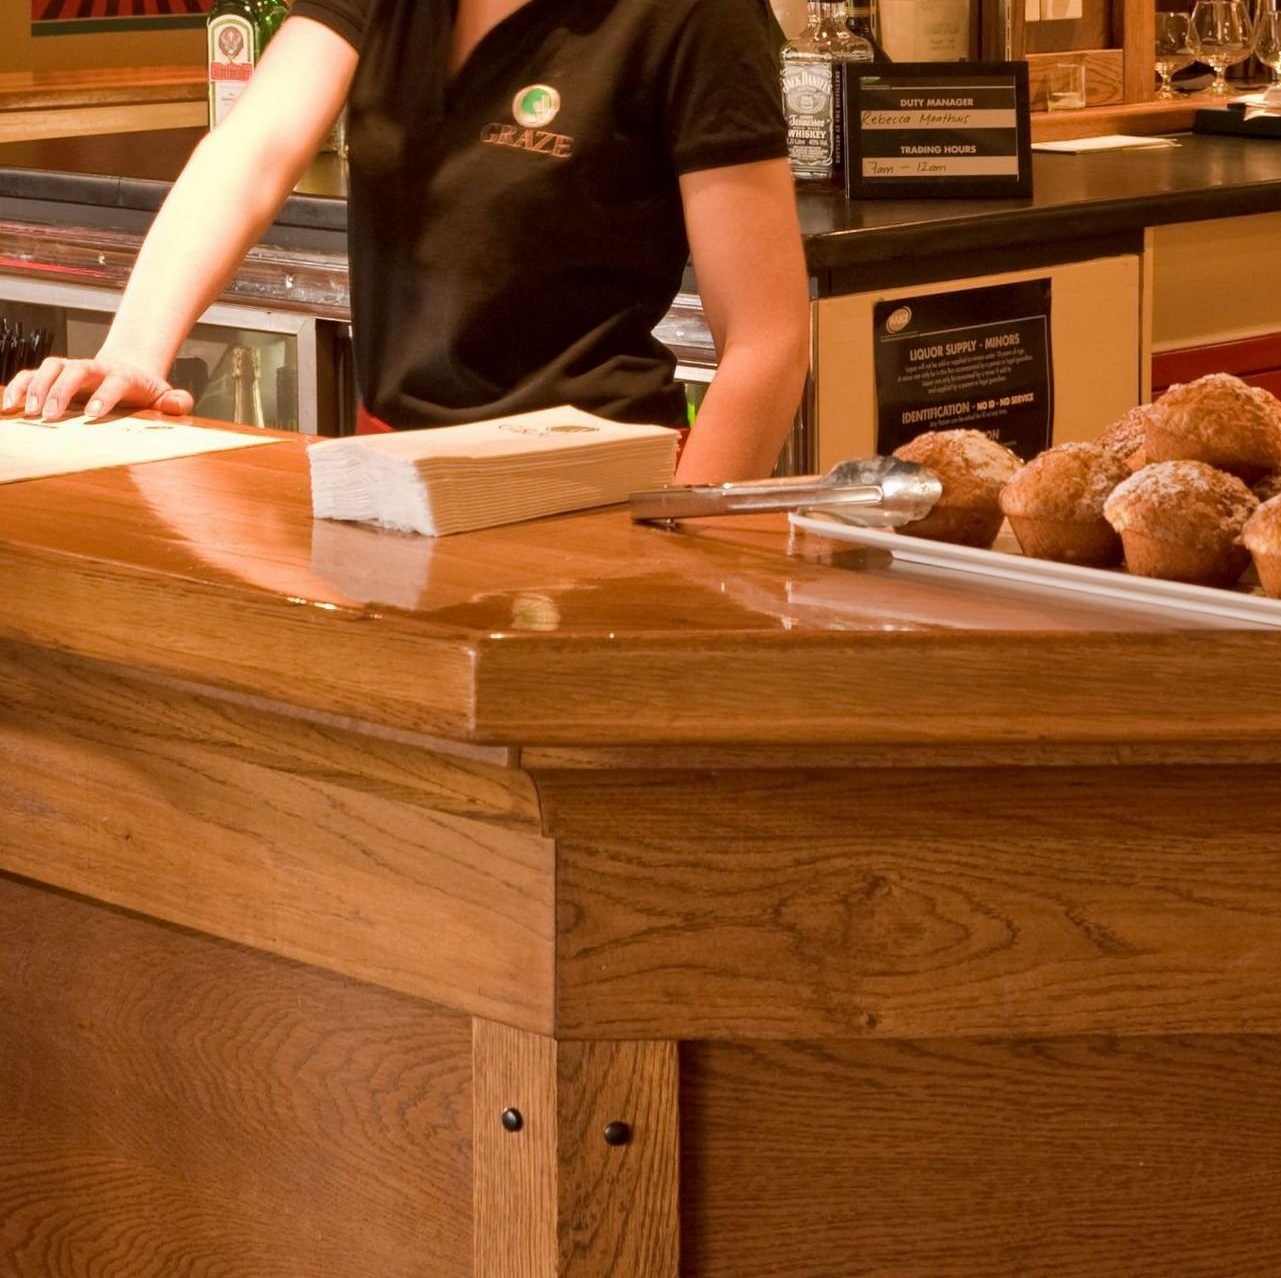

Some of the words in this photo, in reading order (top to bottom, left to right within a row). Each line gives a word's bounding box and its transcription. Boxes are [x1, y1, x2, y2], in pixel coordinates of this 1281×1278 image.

[900, 98, 924, 107] DUTY
[926, 98, 974, 107] MANAGER
[863, 112, 911, 125] Rebecca
[480, 122, 575, 158] GRAZE
[788, 129, 827, 139] WHISKEY
[900, 145, 944, 155] TRADING
[943, 145, 977, 154] HOURS
[867, 161, 894, 174] 7am
[916, 161, 947, 173] 12am
[910, 344, 944, 361] LIQUOR
[945, 339, 977, 356] SUPPLY
[984, 333, 1020, 350] MINORS
[901, 402, 970, 425] IDENTIFICATION
[976, 400, 988, 412] NO
[988, 399, 996, 410] ID
[1011, 392, 1034, 406] SERVICE
